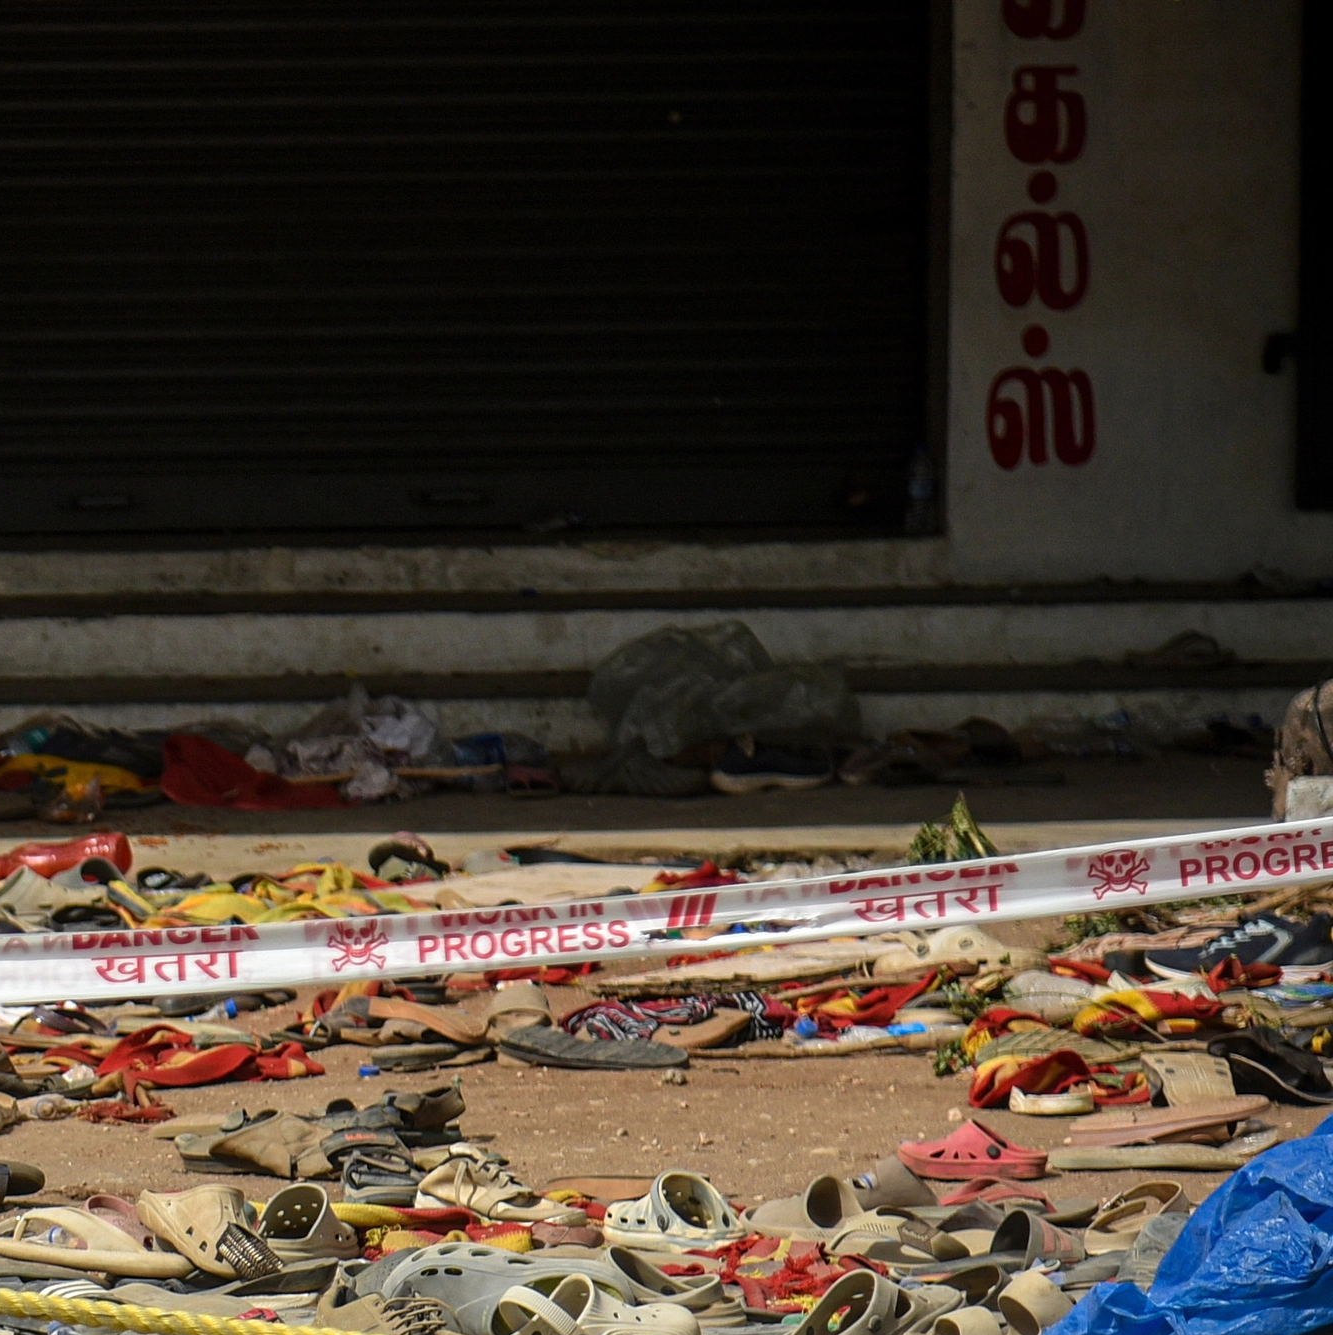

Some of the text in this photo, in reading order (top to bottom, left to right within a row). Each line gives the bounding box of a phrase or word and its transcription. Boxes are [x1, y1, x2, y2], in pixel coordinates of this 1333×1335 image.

[849, 883, 1005, 923] खतरा
[71, 924, 261, 951] DANGER
[418, 919, 632, 964] PROGRESS
[91, 949, 244, 984] खतरा
